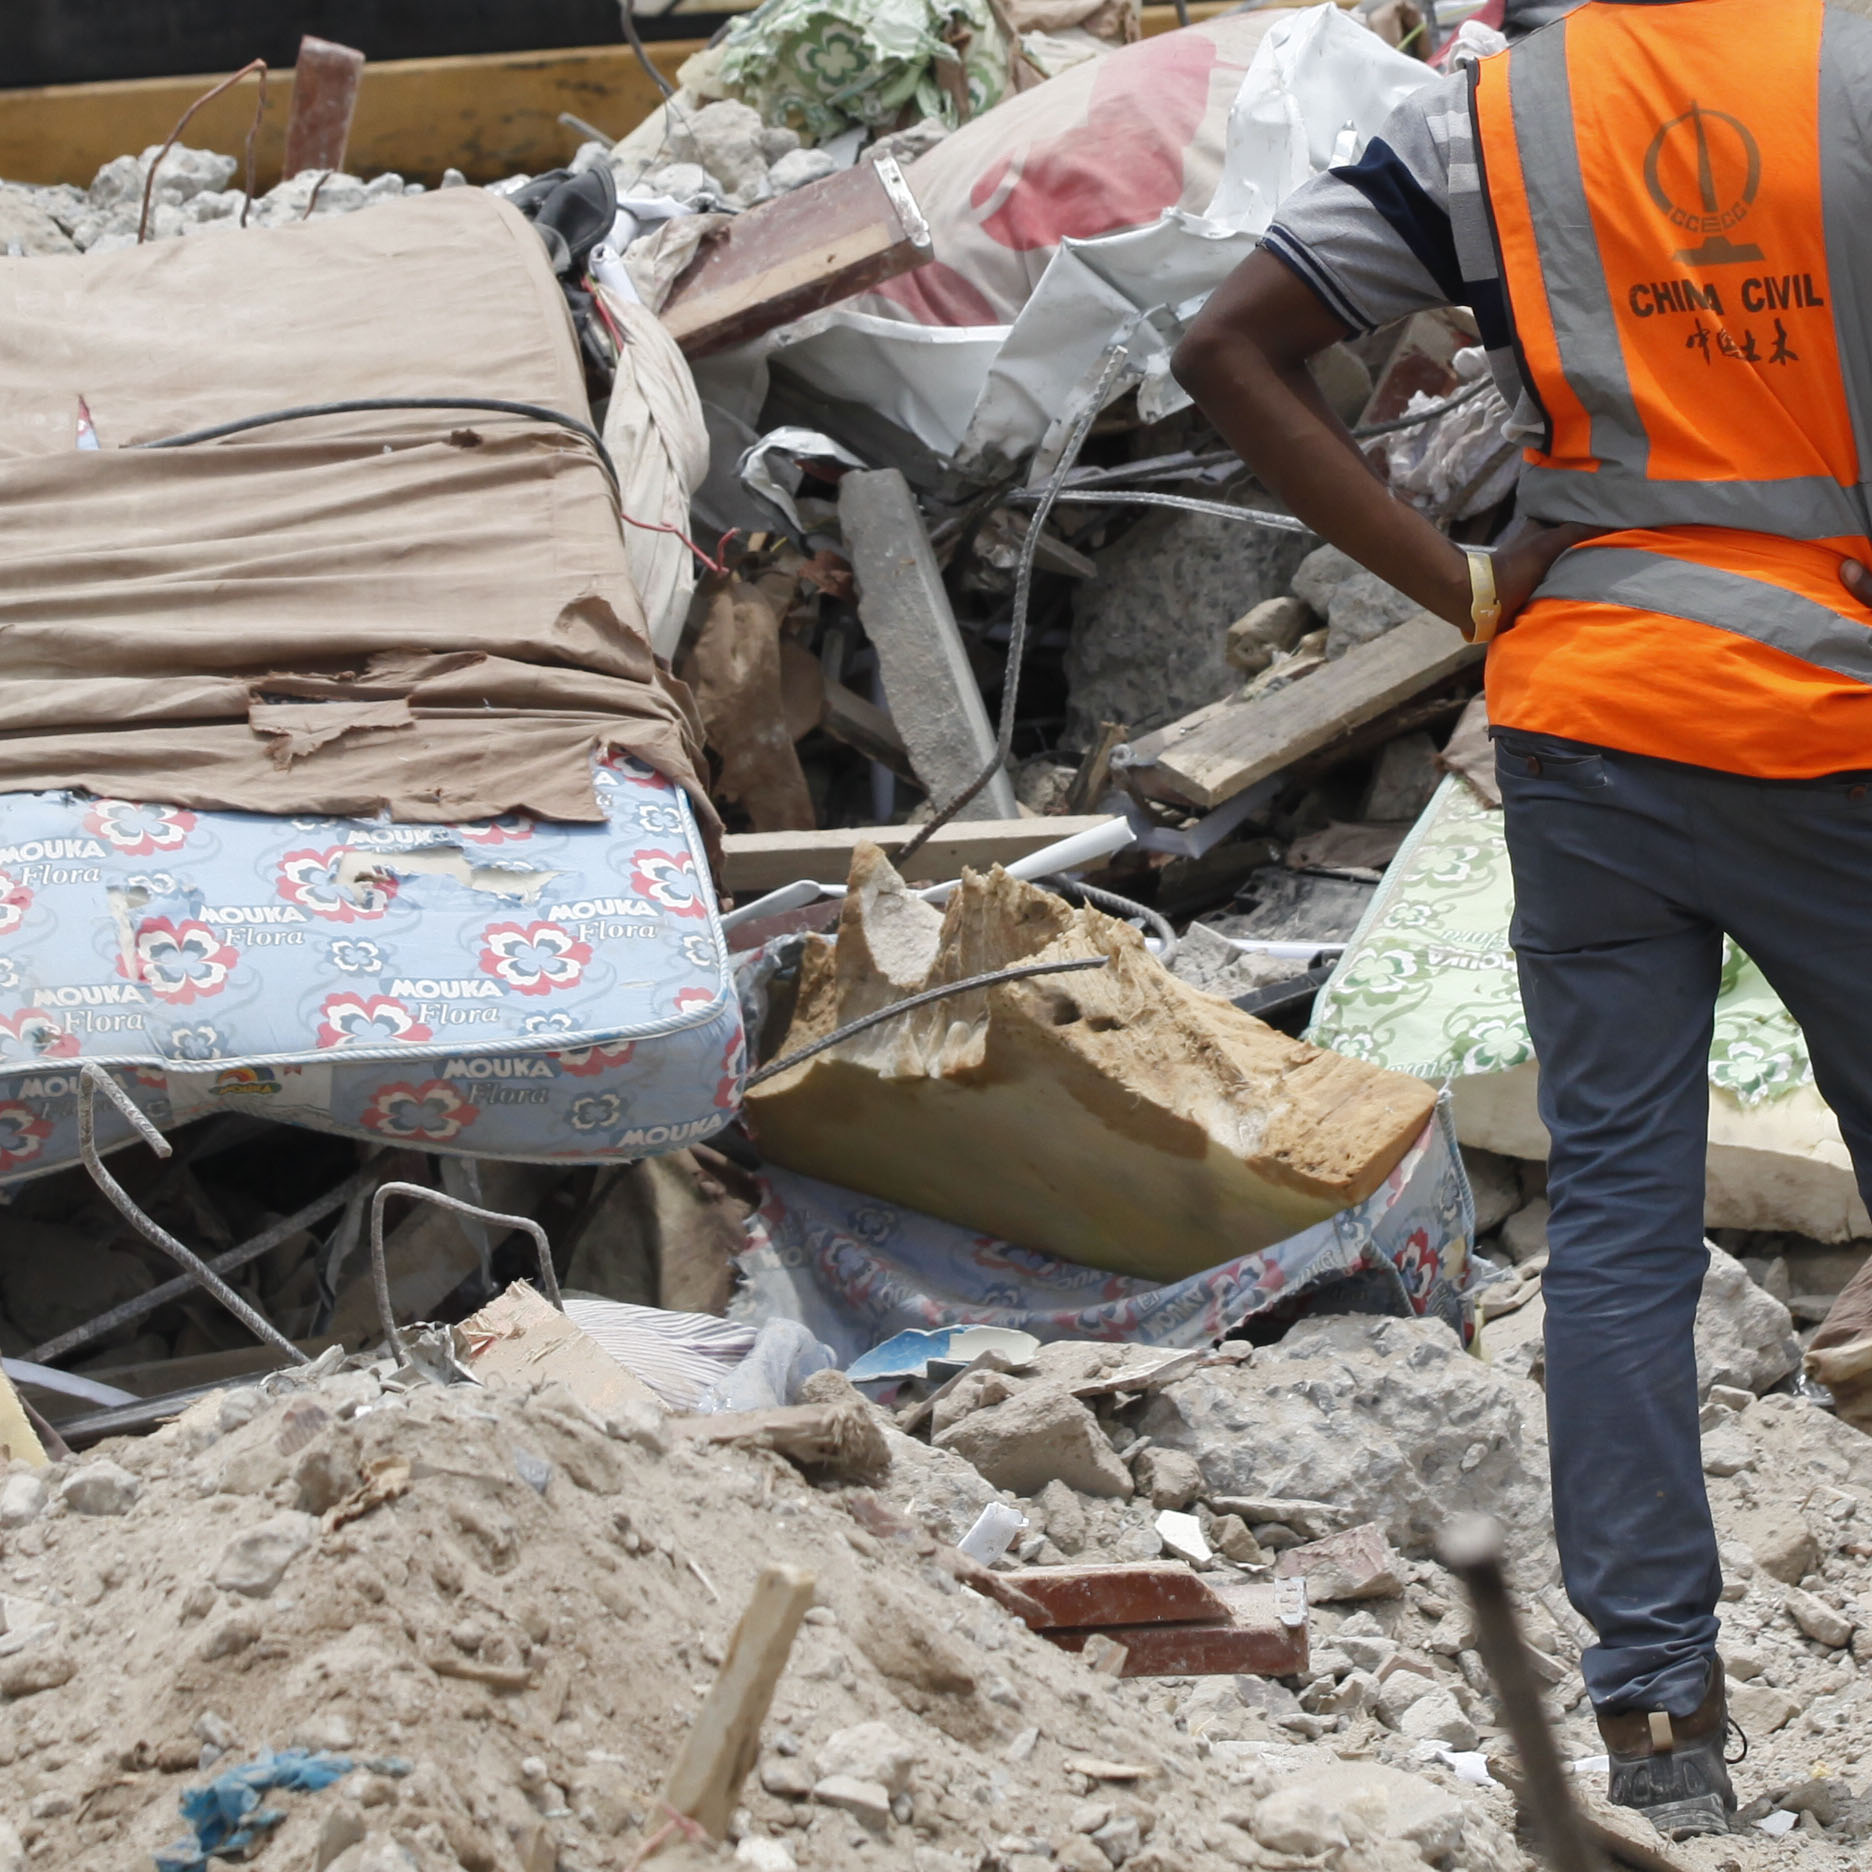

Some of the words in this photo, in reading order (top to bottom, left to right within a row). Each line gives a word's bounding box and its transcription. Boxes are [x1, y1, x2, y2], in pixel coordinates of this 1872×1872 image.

[1669, 201, 1748, 233] CCECC
[1740, 273, 1825, 313] CIVIL
[20, 864, 104, 888] Flora
[197, 903, 307, 925] MOUKA
[547, 898, 660, 922] MOUKA
[223, 926, 305, 948] Flora
[577, 921, 657, 943] Flora
[32, 984, 146, 1008] MOUKA
[388, 977, 504, 1000] MOUKA
[61, 1009, 146, 1034] Flora
[416, 1002, 500, 1025] Flora
[440, 1057, 556, 1080] MOUKA
[466, 1082, 548, 1106] Flora
[616, 1112, 726, 1147] MOUKA
